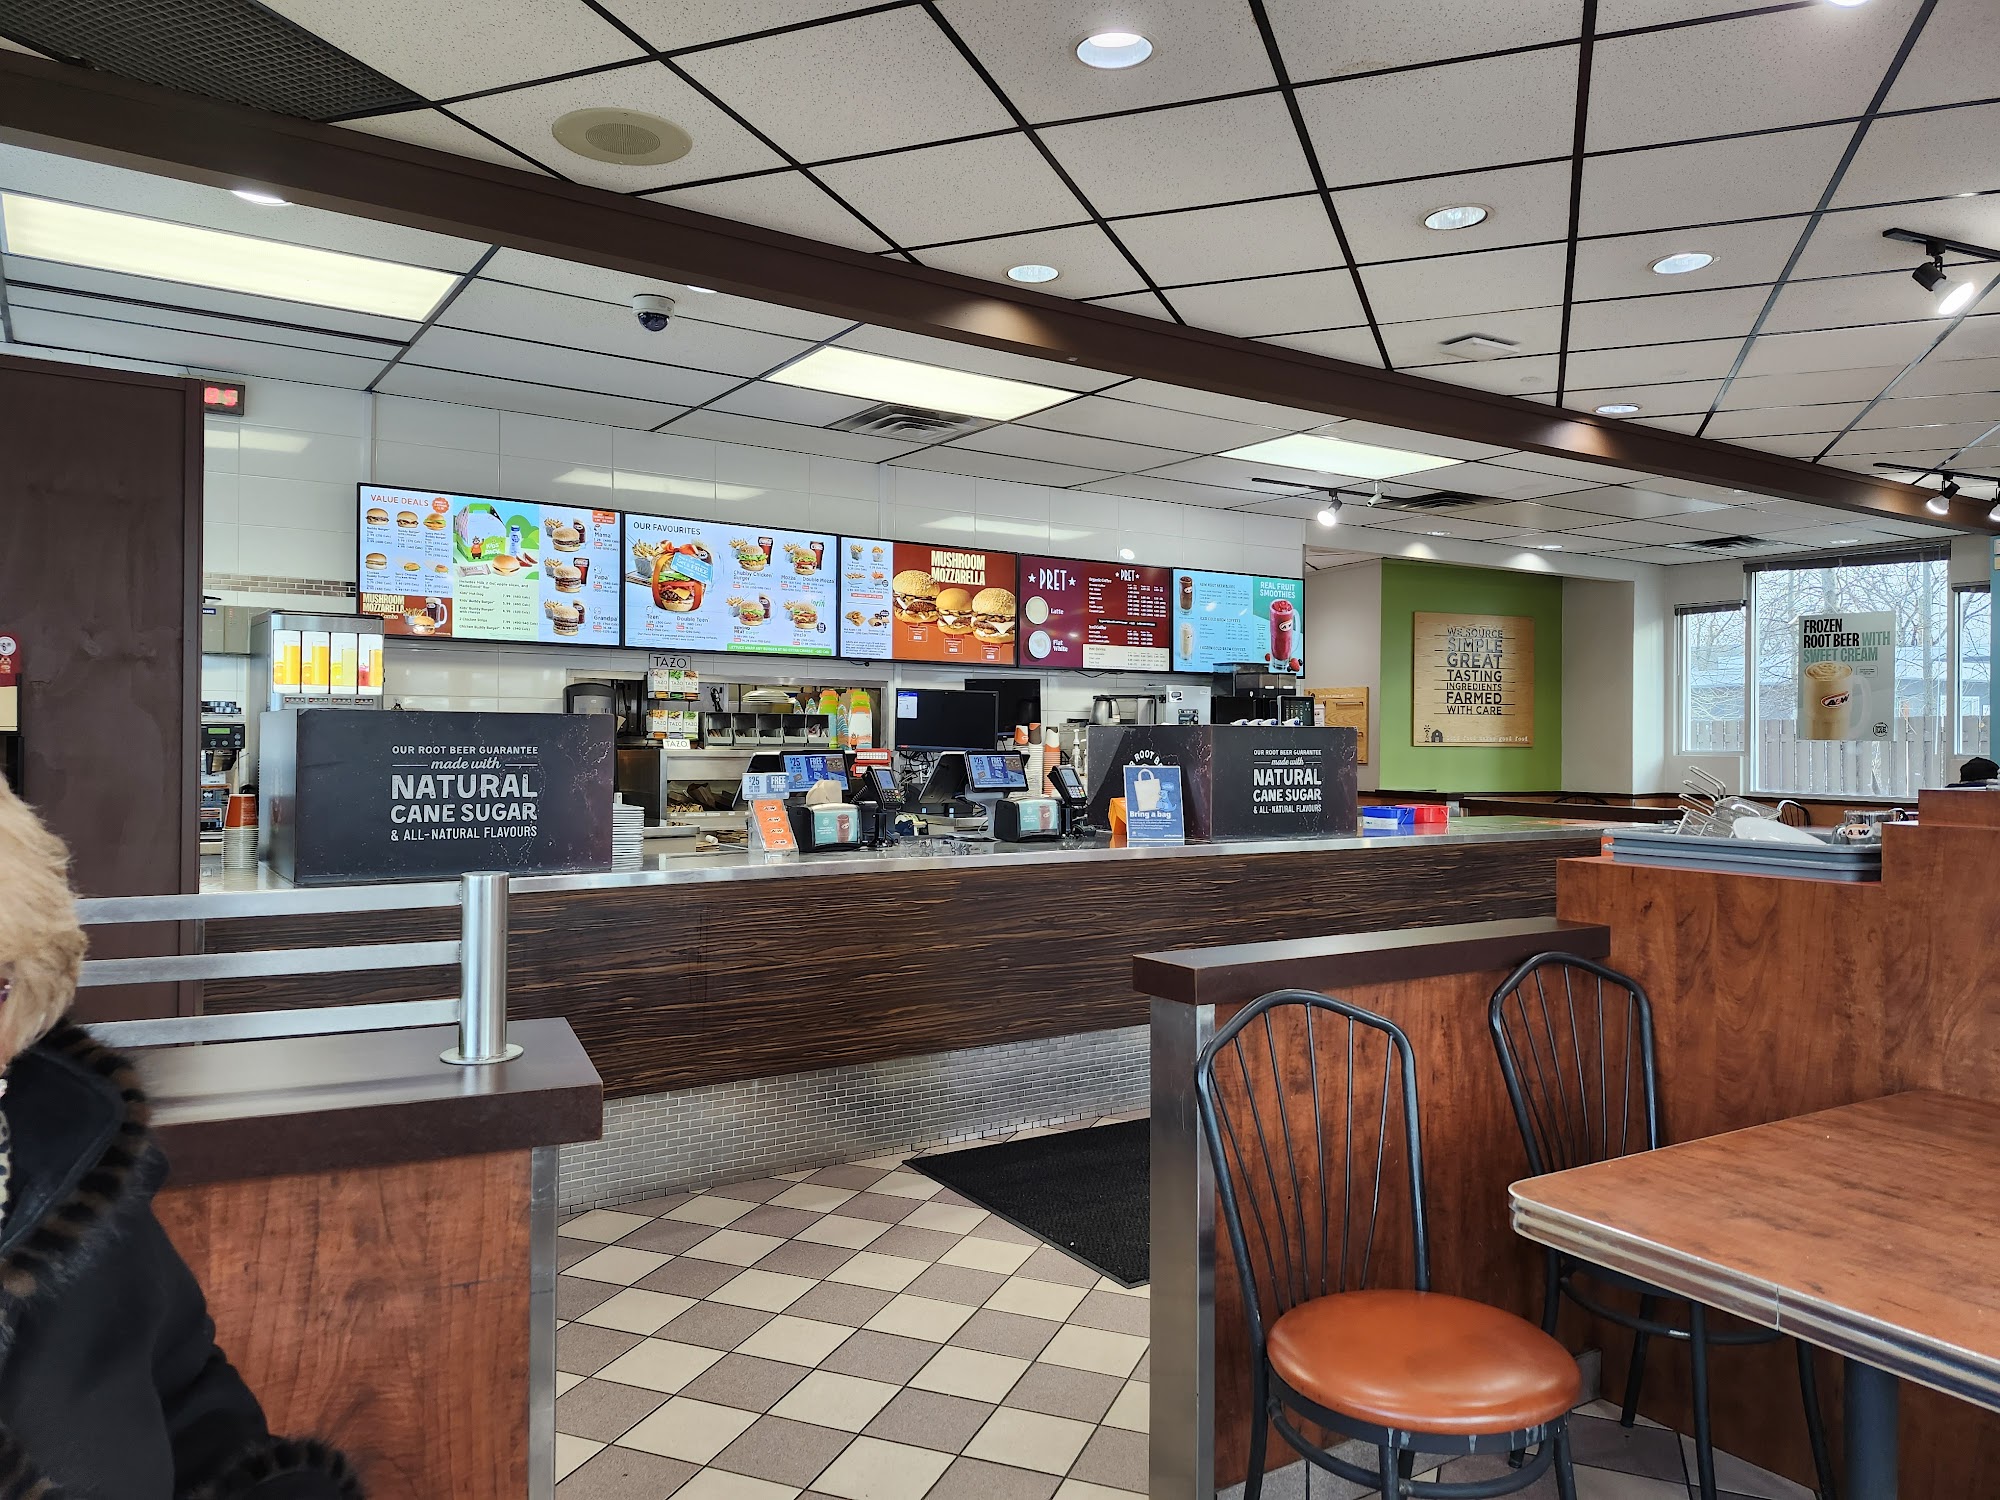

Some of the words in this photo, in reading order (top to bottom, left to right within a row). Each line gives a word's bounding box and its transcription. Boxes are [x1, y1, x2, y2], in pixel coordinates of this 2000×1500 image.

[371, 494, 398, 504] VALUE
[402, 498, 428, 506] DEALS
[634, 522, 650, 530] OUR
[653, 524, 700, 536] FAVOURITES
[931, 550, 985, 570] MUSHROOM
[931, 567, 986, 586] MOZZARELLA
[1040, 568, 1067, 590] PRET
[1120, 569, 1135, 582] PRET
[1260, 582, 1276, 590] REAL
[362, 593, 404, 604] MUSHROOM
[1260, 589, 1296, 598] SMOOTHIES
[362, 603, 404, 614] MOZZARELLA
[1804, 618, 1842, 634] FROZEN
[1447, 628, 1462, 637] WE
[1466, 628, 1503, 638] SOURCE
[1804, 634, 1832, 648] ROOT
[1834, 632, 1860, 647] BEER
[1862, 631, 1890, 646] WITH
[1448, 638, 1502, 653] SIMPLE
[1447, 652, 1502, 668] GREAT
[1804, 648, 1838, 663] SWEET
[1840, 647, 1878, 662] CREAM
[654, 656, 687, 668] TAZO
[1447, 669, 1502, 682] TASTING
[1446, 682, 1502, 691] INGREDIENTS
[1446, 692, 1502, 704] FARMED
[1447, 706, 1472, 714] WITH
[1476, 706, 1502, 715] CARE
[392, 746, 414, 754] OUR
[418, 746, 446, 754] ROOT
[1134, 750, 1154, 762] ROOT
[430, 757, 469, 770] made
[470, 757, 501, 769] with
[1271, 757, 1289, 766] made
[1290, 757, 1304, 766] with
[749, 776, 760, 786] $25
[771, 776, 786, 784] FREE
[1254, 768, 1322, 786] NATURAL
[392, 774, 538, 800] NATURAL
[1253, 789, 1284, 802] CANE
[1285, 788, 1322, 801] SUGAR
[390, 804, 456, 823] CANE
[460, 802, 538, 822] SUGAR
[1254, 806, 1258, 814] &
[1259, 805, 1295, 814] ALL-NATURAL
[1296, 804, 1322, 812] FLAVOURS
[390, 830, 398, 841] &
[404, 828, 480, 840] ALL-NATURAL
[484, 826, 537, 838] FLAVOURS
